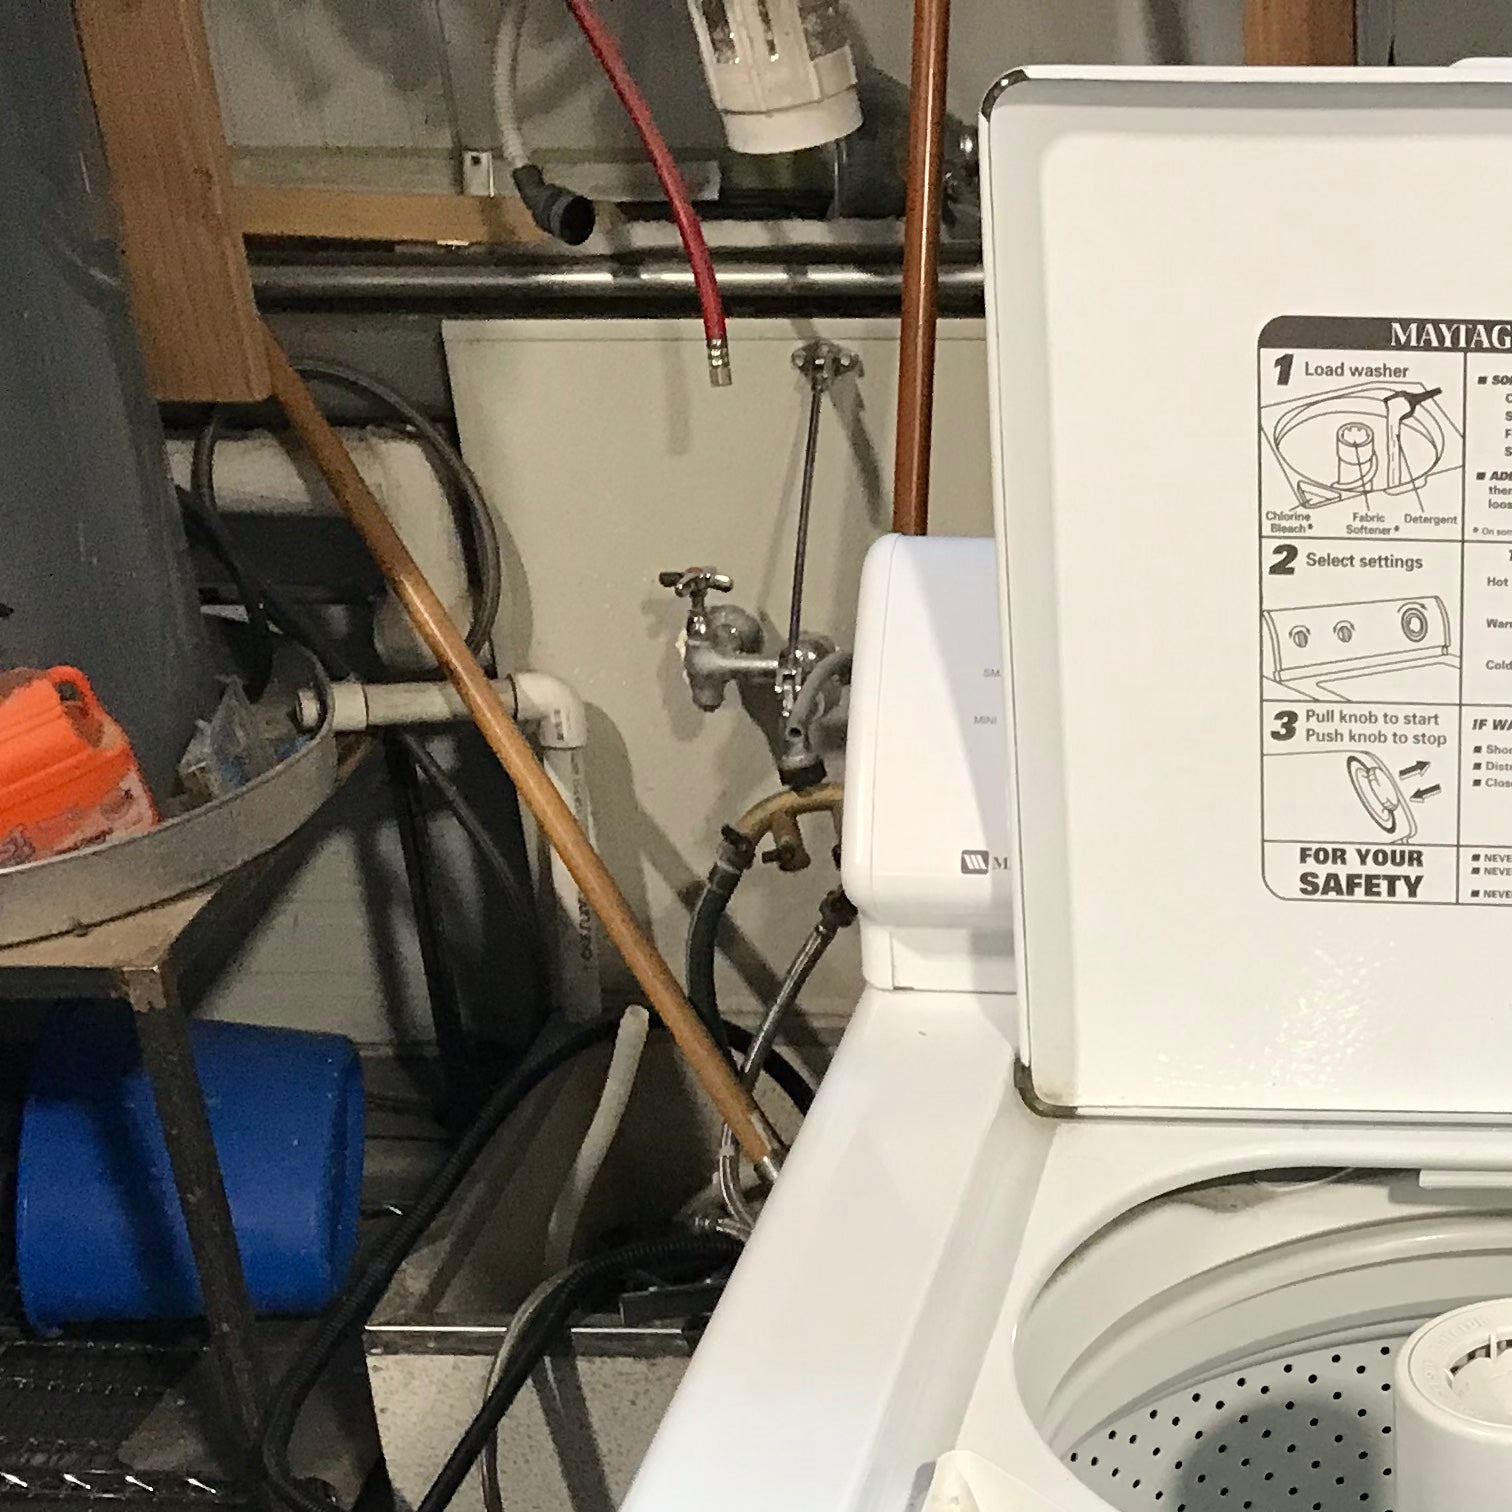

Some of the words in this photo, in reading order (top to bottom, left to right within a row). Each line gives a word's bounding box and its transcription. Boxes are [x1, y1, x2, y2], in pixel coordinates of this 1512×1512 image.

[1390, 322, 1512, 349] MAYTAG
[1274, 354, 1294, 385] 1
[1305, 361, 1344, 377] Load
[1350, 363, 1409, 378] washer
[1265, 511, 1311, 521] Chlorine
[1352, 512, 1385, 523] Fabric
[1404, 514, 1458, 526] Detergent
[1268, 544, 1299, 575] 2
[1306, 552, 1355, 568] Select
[1360, 554, 1423, 571] settings
[1487, 577, 1509, 587] Hot
[1486, 660, 1512, 670] Cold
[1270, 710, 1299, 742] 3
[1305, 709, 1334, 724] Pull
[1339, 710, 1378, 725] knob
[1383, 713, 1399, 725] to
[1403, 712, 1440, 726] start
[1471, 719, 1488, 730] IF
[1305, 729, 1344, 742] Push
[1348, 730, 1388, 743] knob
[1392, 733, 1407, 744] to
[1412, 732, 1448, 747] stop
[1299, 847, 1348, 866] FOR
[1354, 849, 1424, 867] YOUR
[1299, 872, 1424, 898] SAFETY
